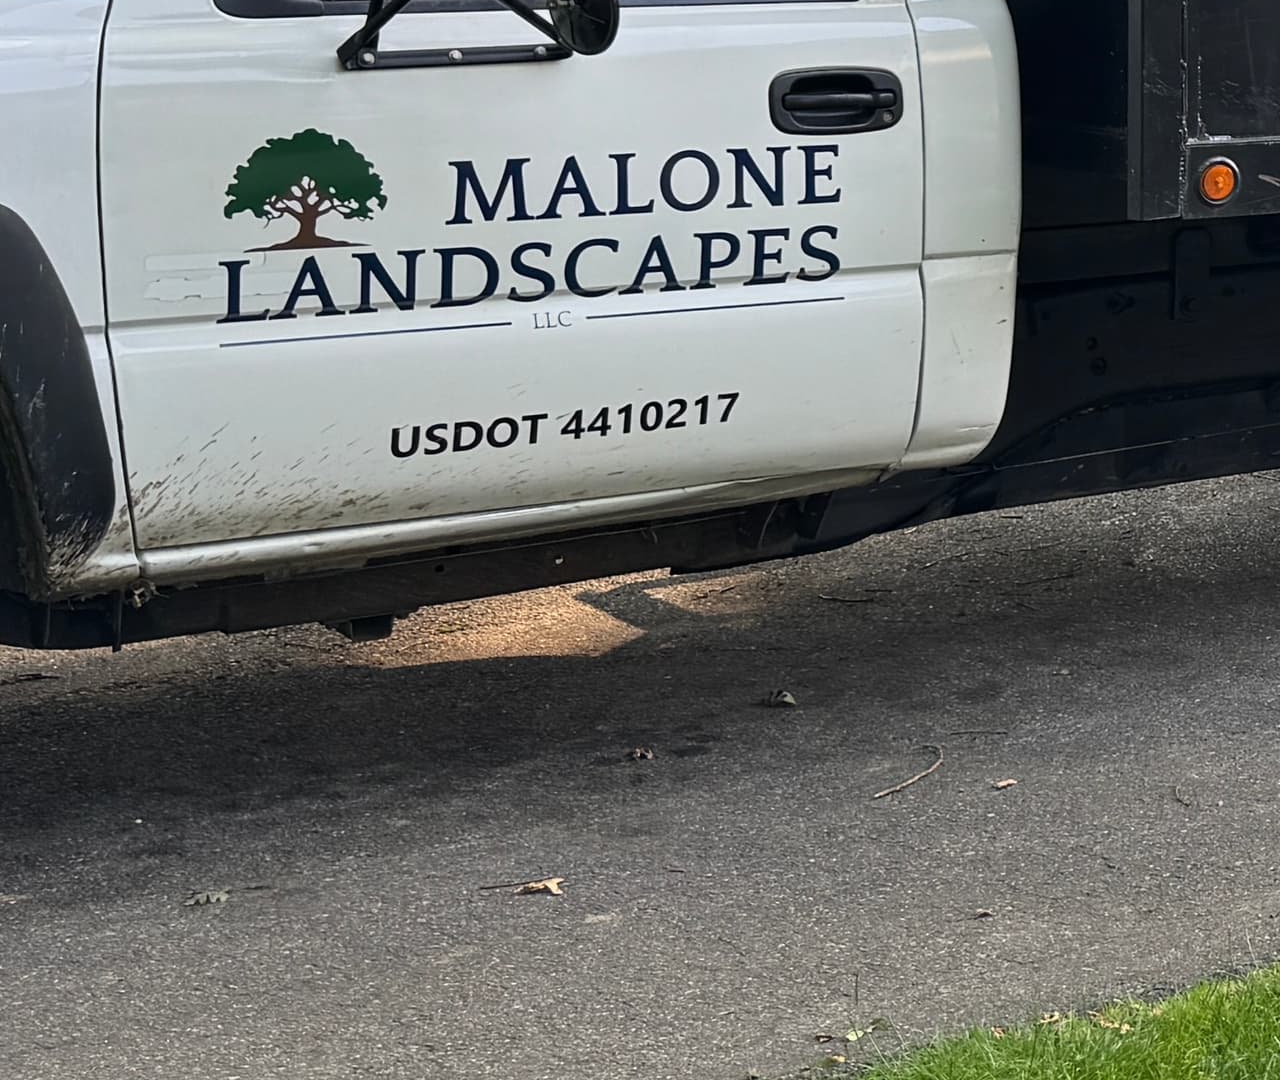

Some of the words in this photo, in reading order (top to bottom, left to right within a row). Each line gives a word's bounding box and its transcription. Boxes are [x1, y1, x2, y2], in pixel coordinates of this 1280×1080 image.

[446, 144, 842, 225] MALONE
[216, 225, 841, 324] LANDSCAPES
[533, 311, 573, 329] LLC
[390, 413, 549, 458] USDOT
[560, 392, 740, 440] 4410217
